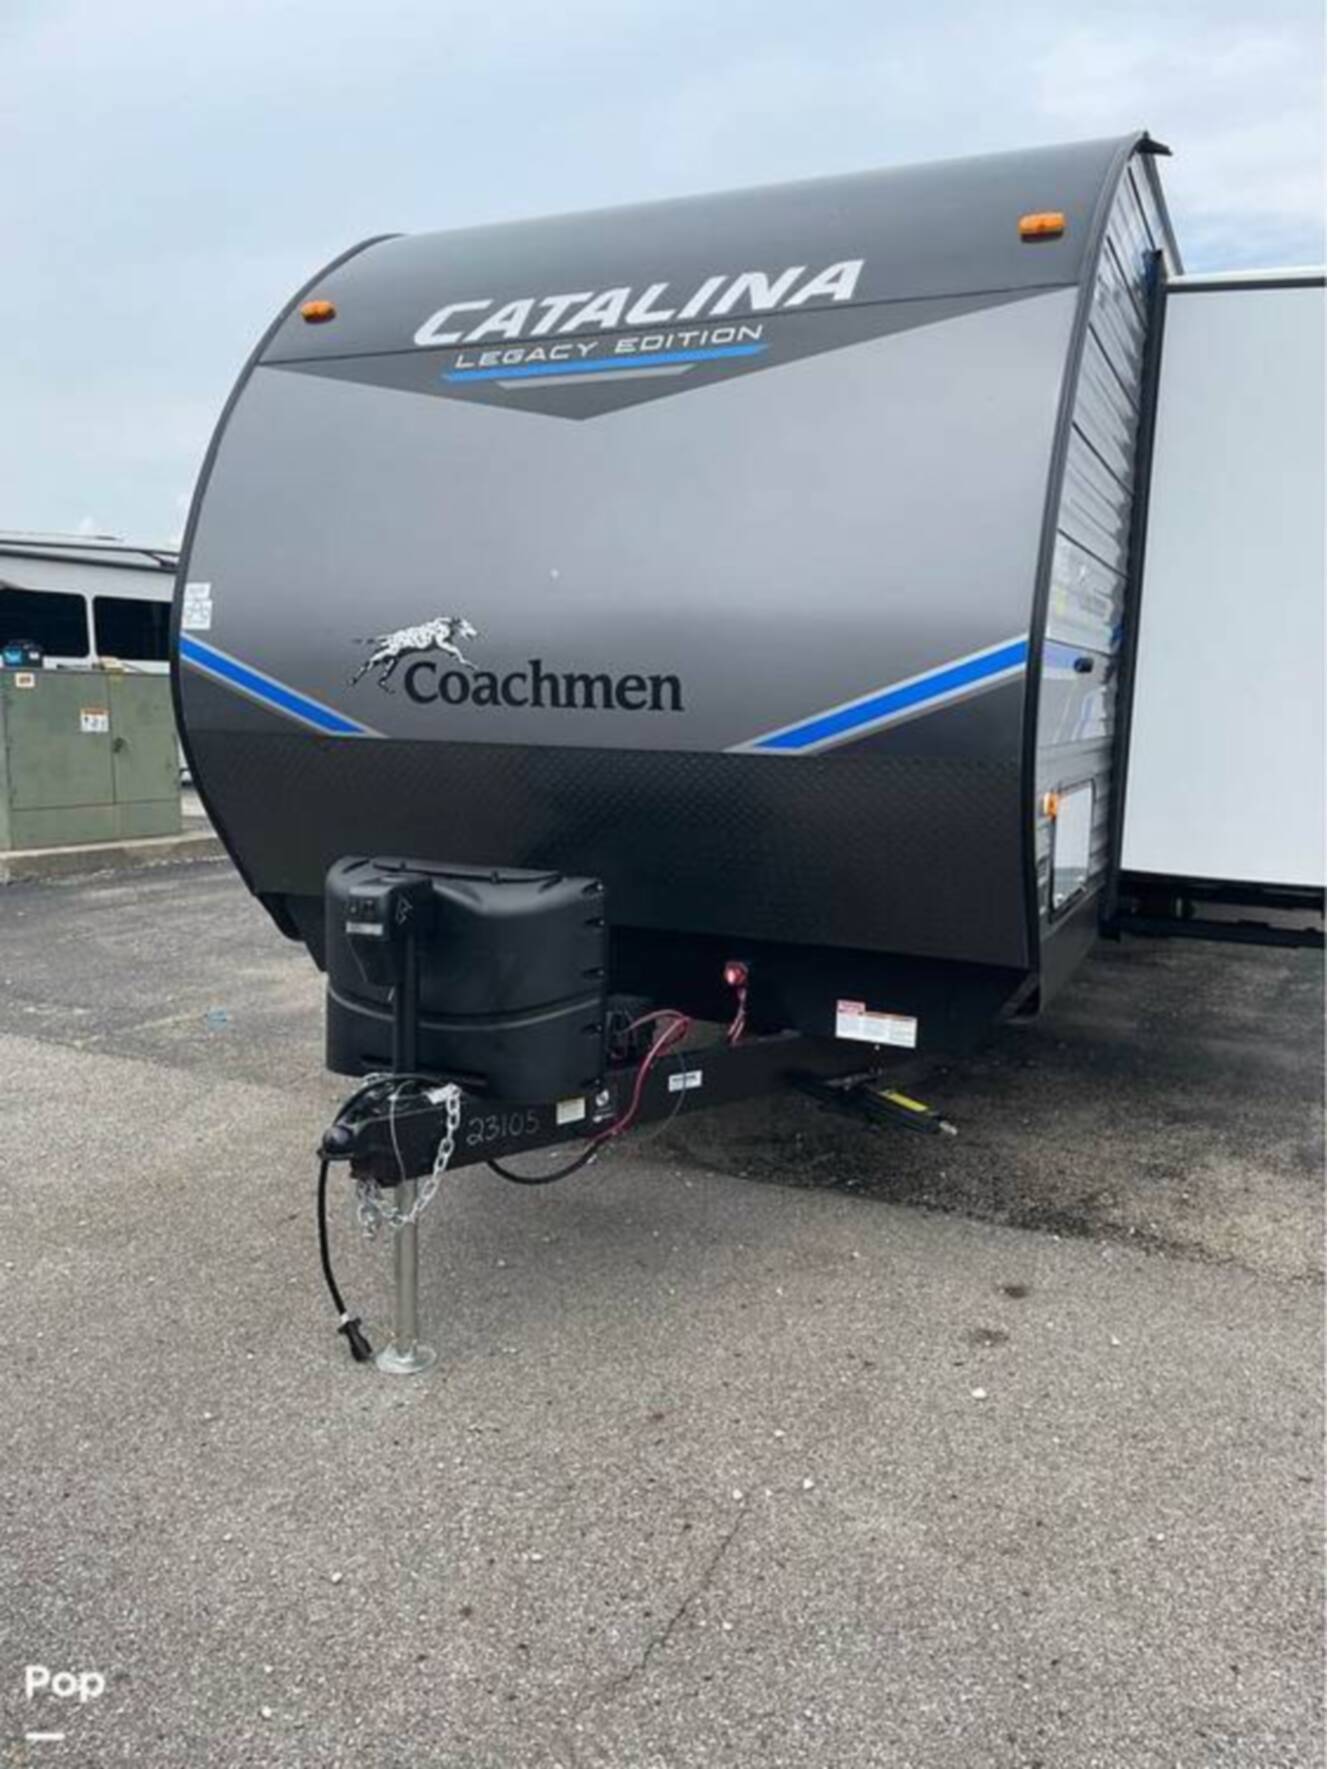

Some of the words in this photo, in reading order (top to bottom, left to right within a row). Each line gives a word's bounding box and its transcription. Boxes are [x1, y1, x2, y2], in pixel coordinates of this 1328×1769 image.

[413, 259, 865, 347] CATALINA
[454, 341, 598, 370] LEGACY
[614, 324, 764, 355] EDITION
[403, 659, 685, 712] Coachmen
[466, 1109, 541, 1146] 23105
